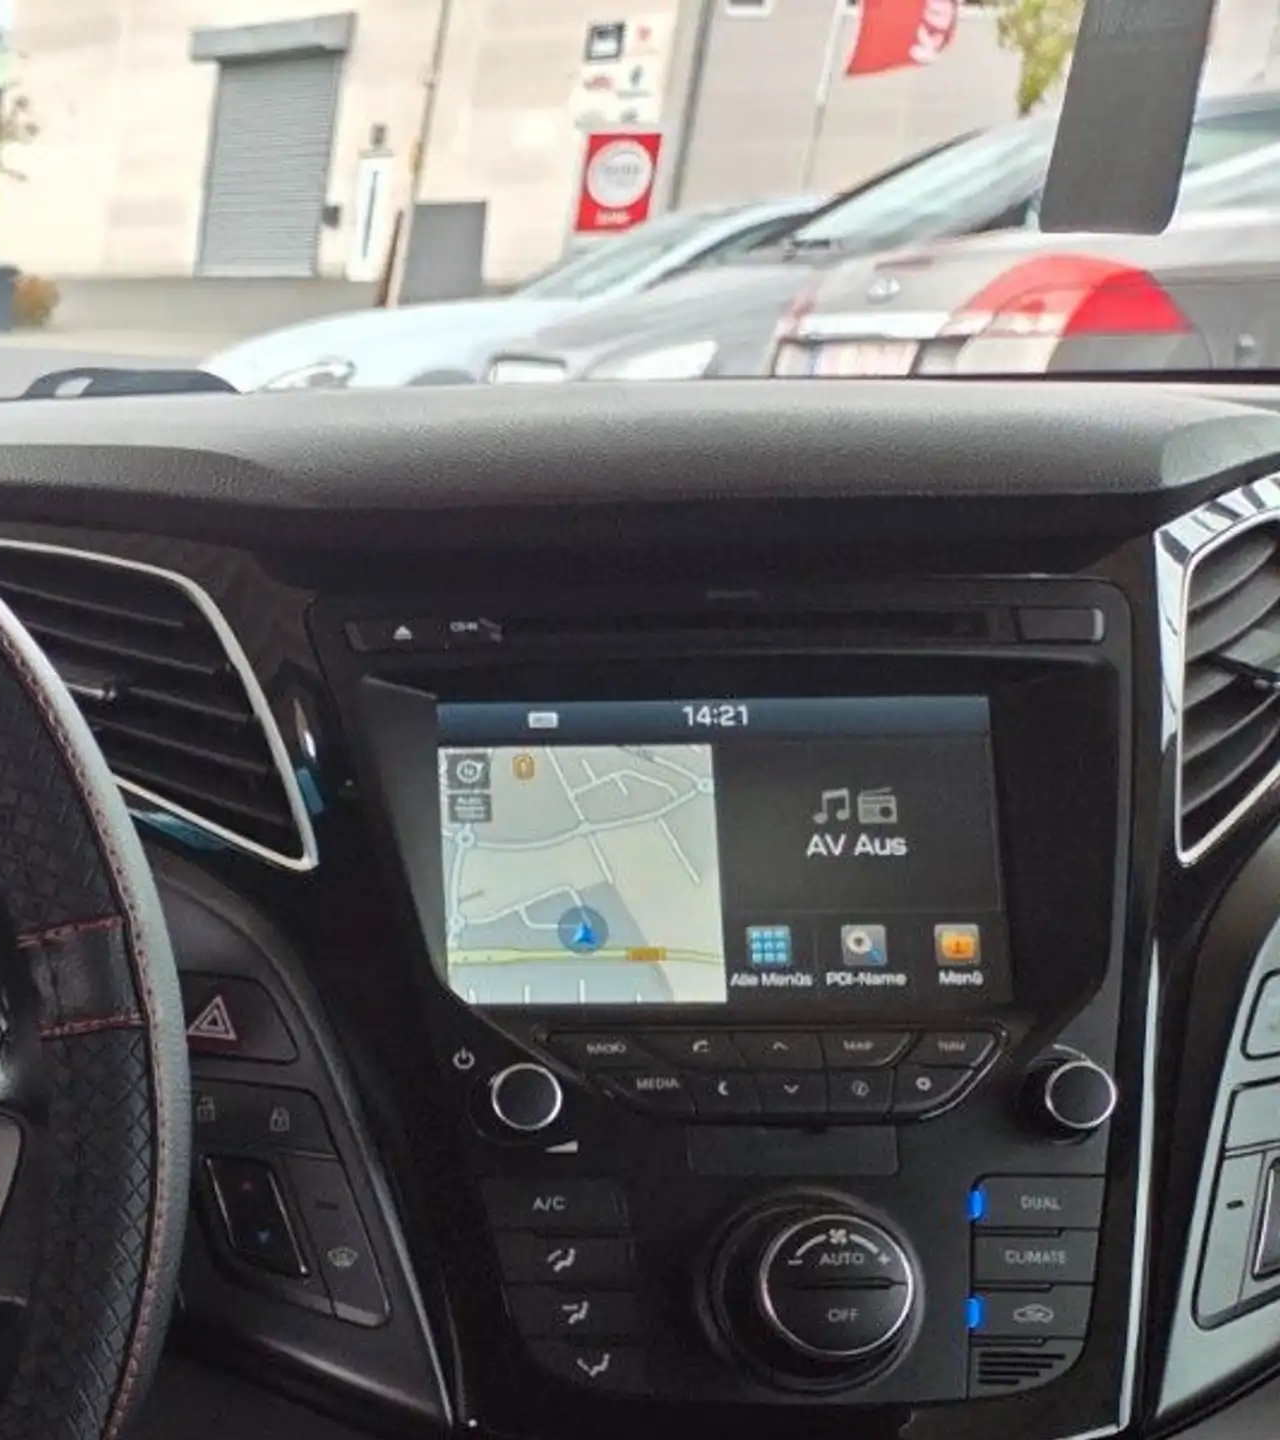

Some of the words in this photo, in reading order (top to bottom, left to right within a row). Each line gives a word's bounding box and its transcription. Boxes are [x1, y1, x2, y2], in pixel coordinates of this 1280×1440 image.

[681, 705, 750, 728] 14:21
[806, 833, 847, 858] AV
[854, 833, 909, 857] Aus
[636, 1076, 680, 1090] MEDIA
[531, 1195, 568, 1212] A/C
[1020, 1194, 1063, 1211] DUAL
[819, 1252, 865, 1266] AUTO
[1004, 1249, 1067, 1265] CLIMATE
[827, 1307, 861, 1323] OFF
